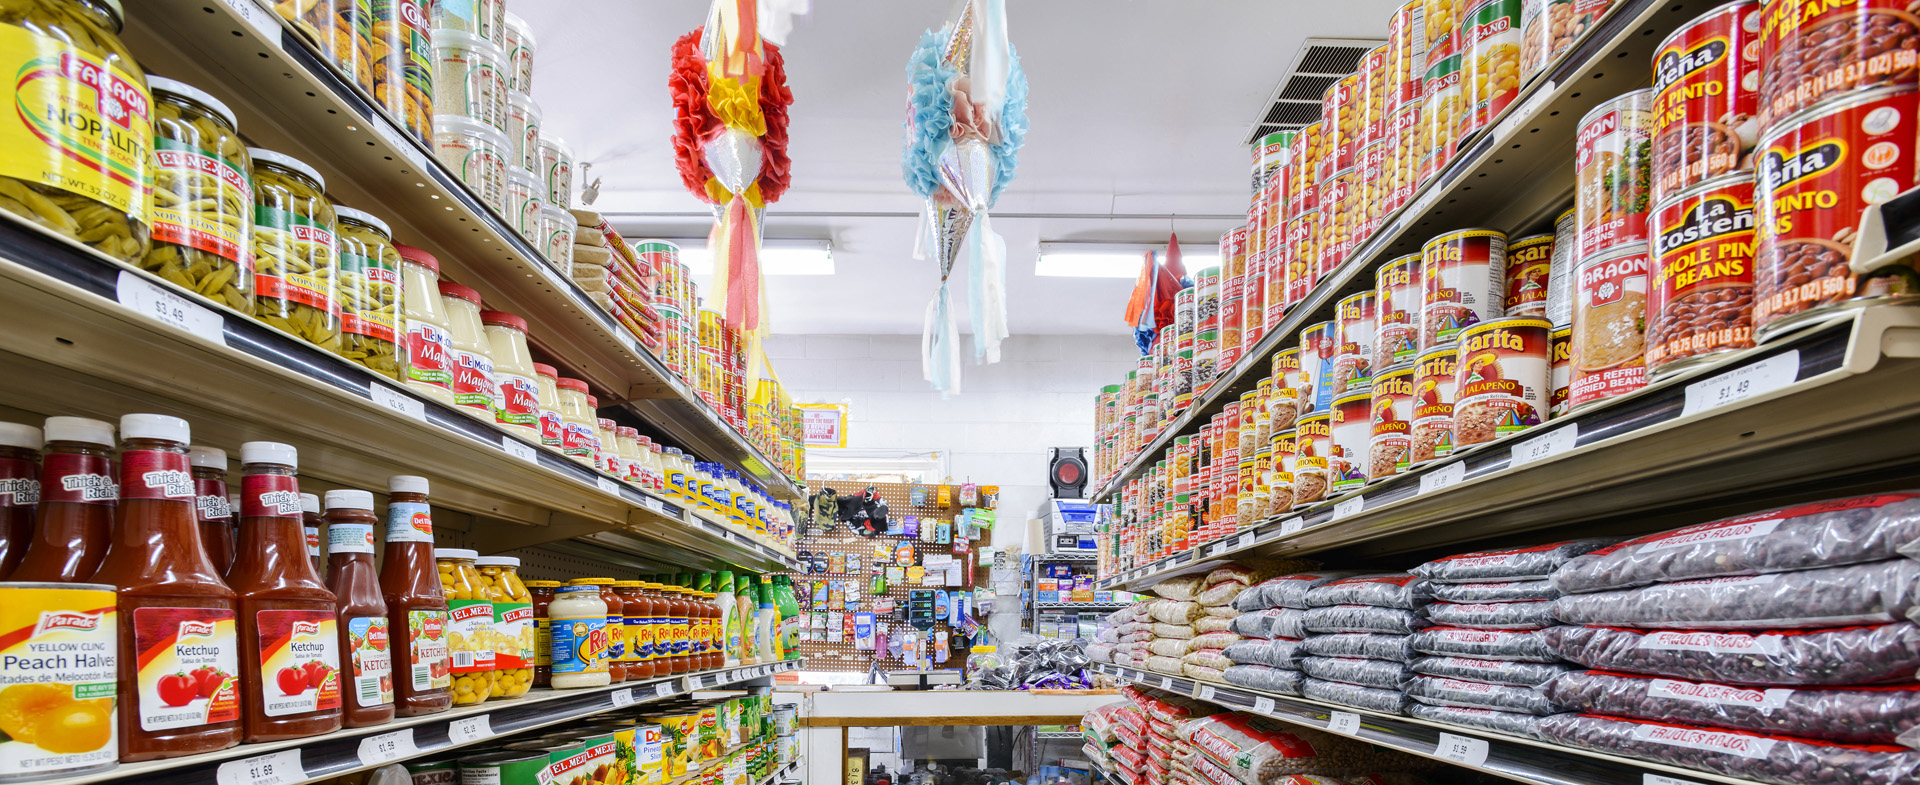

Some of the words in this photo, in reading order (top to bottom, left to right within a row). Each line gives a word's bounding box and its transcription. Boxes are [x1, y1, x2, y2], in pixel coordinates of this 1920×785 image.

[1656, 53, 1674, 78] La
[1796, 80, 1812, 102] OZ
[1826, 67, 1845, 91] LB
[1846, 60, 1867, 86] 3.7
[1868, 53, 1893, 77] OZ)
[1894, 49, 1918, 70] 560
[59, 52, 147, 117] FARAON
[1668, 79, 1724, 108] PINTO
[1387, 113, 1416, 136] RAON
[1653, 103, 1688, 143] EANS
[47, 103, 153, 170] NOPALITOS
[1577, 117, 1616, 149] RAON
[1355, 152, 1385, 174] FARAO
[1709, 151, 1728, 171] 560
[1728, 154, 1738, 169] g
[160, 153, 181, 166] EL
[186, 154, 254, 201] MEXICANO
[89, 186, 102, 196] 32
[1772, 189, 1839, 218] PINTO
[1696, 203, 1726, 223] La
[297, 226, 311, 239] EL
[1583, 230, 1615, 249] BEANS
[1659, 211, 1753, 255] Costeñ
[1327, 241, 1352, 257] BEANS
[1652, 246, 1712, 291] WHOLE
[1718, 242, 1755, 260] PIN
[368, 269, 380, 281] EL
[1675, 259, 1745, 291] BEANS
[290, 275, 329, 292] NOPALITO
[1784, 287, 1800, 309] 3.7
[1801, 281, 1822, 302] OZ)
[1822, 274, 1846, 297] 560
[1846, 277, 1857, 296] g
[1521, 290, 1548, 303] JALAP
[155, 300, 183, 322] $3.49
[1670, 337, 1692, 356] 19.75
[1692, 333, 1706, 351] OZ
[1707, 330, 1717, 350] (1
[1718, 329, 1733, 347] LB
[1734, 326, 1751, 345] 3.7
[1414, 359, 1457, 383] sarita
[1466, 379, 1517, 397] JALAPEÑO
[1572, 383, 1607, 398] REFRIED
[1609, 376, 1647, 390] BEANS
[1718, 379, 1750, 400] $1.49
[1415, 404, 1453, 418] JALAPEÑO
[1488, 402, 1519, 410] FIBER
[1374, 422, 1407, 435] JALAPEÑO
[1531, 442, 1550, 457] $1.29
[64, 476, 100, 490] Thick
[102, 477, 112, 487] &
[145, 472, 180, 487] Thick
[181, 472, 191, 482] &
[197, 497, 219, 508] hick
[262, 493, 291, 505] Thick
[414, 517, 423, 525] Del
[1655, 529, 1709, 550] FRIJOLES
[1714, 523, 1756, 539] ROJOS
[48, 615, 96, 629] Parade
[454, 610, 469, 621] EL
[506, 611, 519, 622] EL
[184, 624, 210, 635] Parade
[296, 624, 318, 634] Parade
[424, 623, 432, 632] Del
[432, 624, 442, 632] Monte
[369, 631, 378, 641] Del
[1656, 634, 1712, 648] FRIJOLES
[1713, 636, 1755, 649] ROJOS
[30, 643, 79, 652] YELLOW
[177, 645, 220, 657] Ketchup
[291, 643, 325, 653] Ketchup
[420, 646, 447, 659] KETCHUP
[3, 655, 68, 670] Peach
[75, 653, 116, 669] Halves
[0, 674, 35, 684] itades
[38, 674, 52, 683] de
[55, 671, 101, 682] Melocotón
[1664, 682, 1720, 699] FRIJOLES
[1721, 688, 1766, 704] ROJOS
[646, 731, 661, 743] Dol
[1648, 728, 1707, 746] FRIJOLES
[1709, 736, 1751, 753] ROJOS
[250, 764, 273, 779] $1.69
